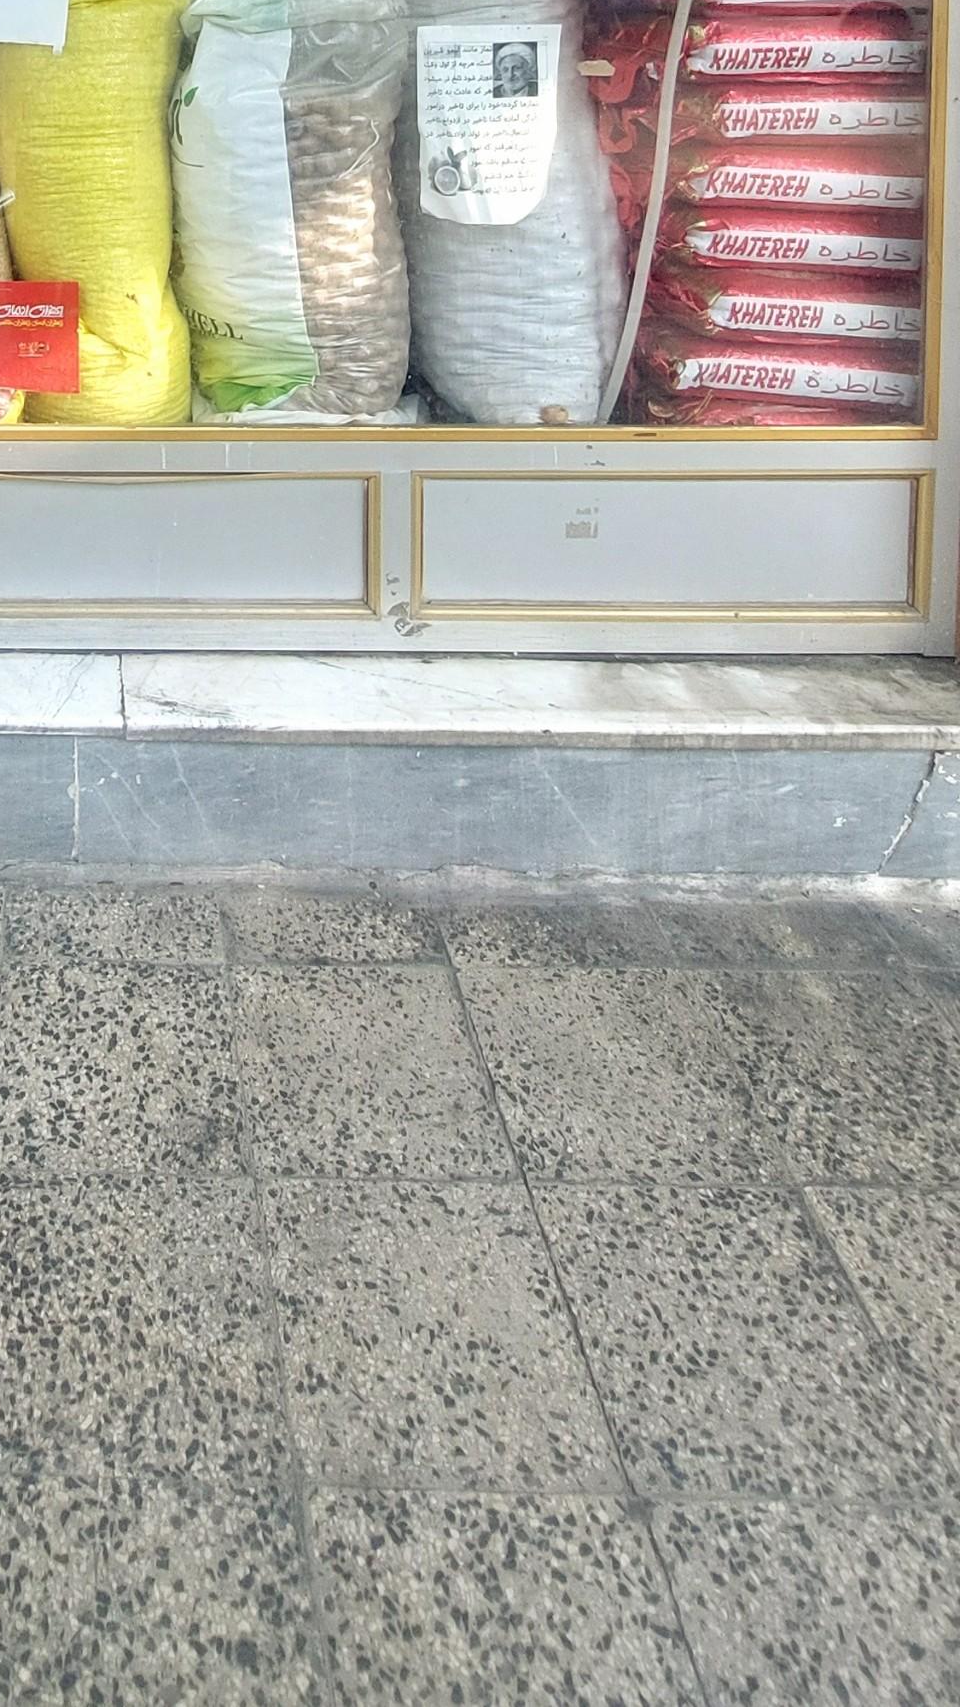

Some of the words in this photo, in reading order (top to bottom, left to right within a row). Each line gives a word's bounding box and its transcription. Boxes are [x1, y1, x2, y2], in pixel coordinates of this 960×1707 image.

[708, 45, 813, 71] KHATEREH
[821, 45, 918, 68] خاطره
[718, 107, 820, 133] KHATEREH
[828, 107, 923, 130] خاطره
[704, 170, 810, 199] KHATEREH
[818, 179, 915, 202] خاطره
[706, 232, 810, 261] KHATEREH
[817, 240, 913, 263] خاطره
[726, 301, 824, 329] KHATEREH
[832, 309, 921, 333] خاطره
[691, 361, 797, 390] KHATEREH
